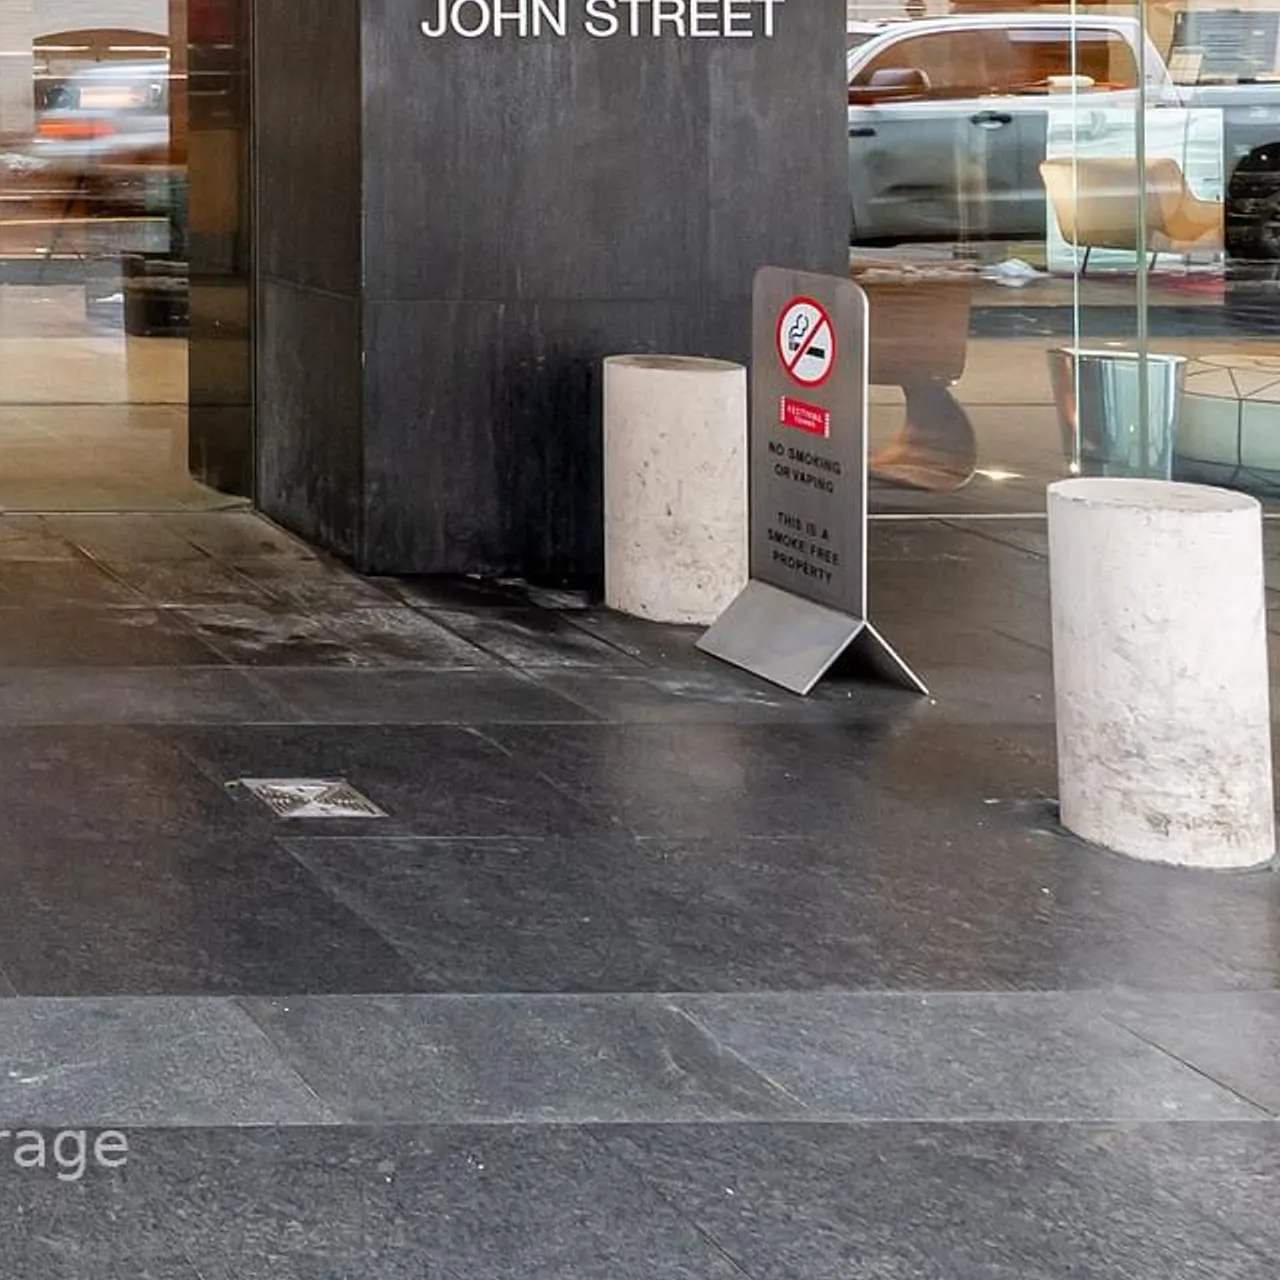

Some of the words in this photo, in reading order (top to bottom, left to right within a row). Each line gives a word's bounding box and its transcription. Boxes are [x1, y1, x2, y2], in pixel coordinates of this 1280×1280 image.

[768, 440, 785, 456] NO
[788, 447, 842, 475] SMOKING
[774, 463, 790, 479] OR
[792, 472, 834, 494] VAPING
[778, 512, 801, 531] THIS
[806, 522, 817, 537] IS
[821, 528, 829, 540] A
[767, 528, 805, 553] SMOKE
[810, 543, 840, 566] FREE
[772, 549, 832, 584] PROPERTY
